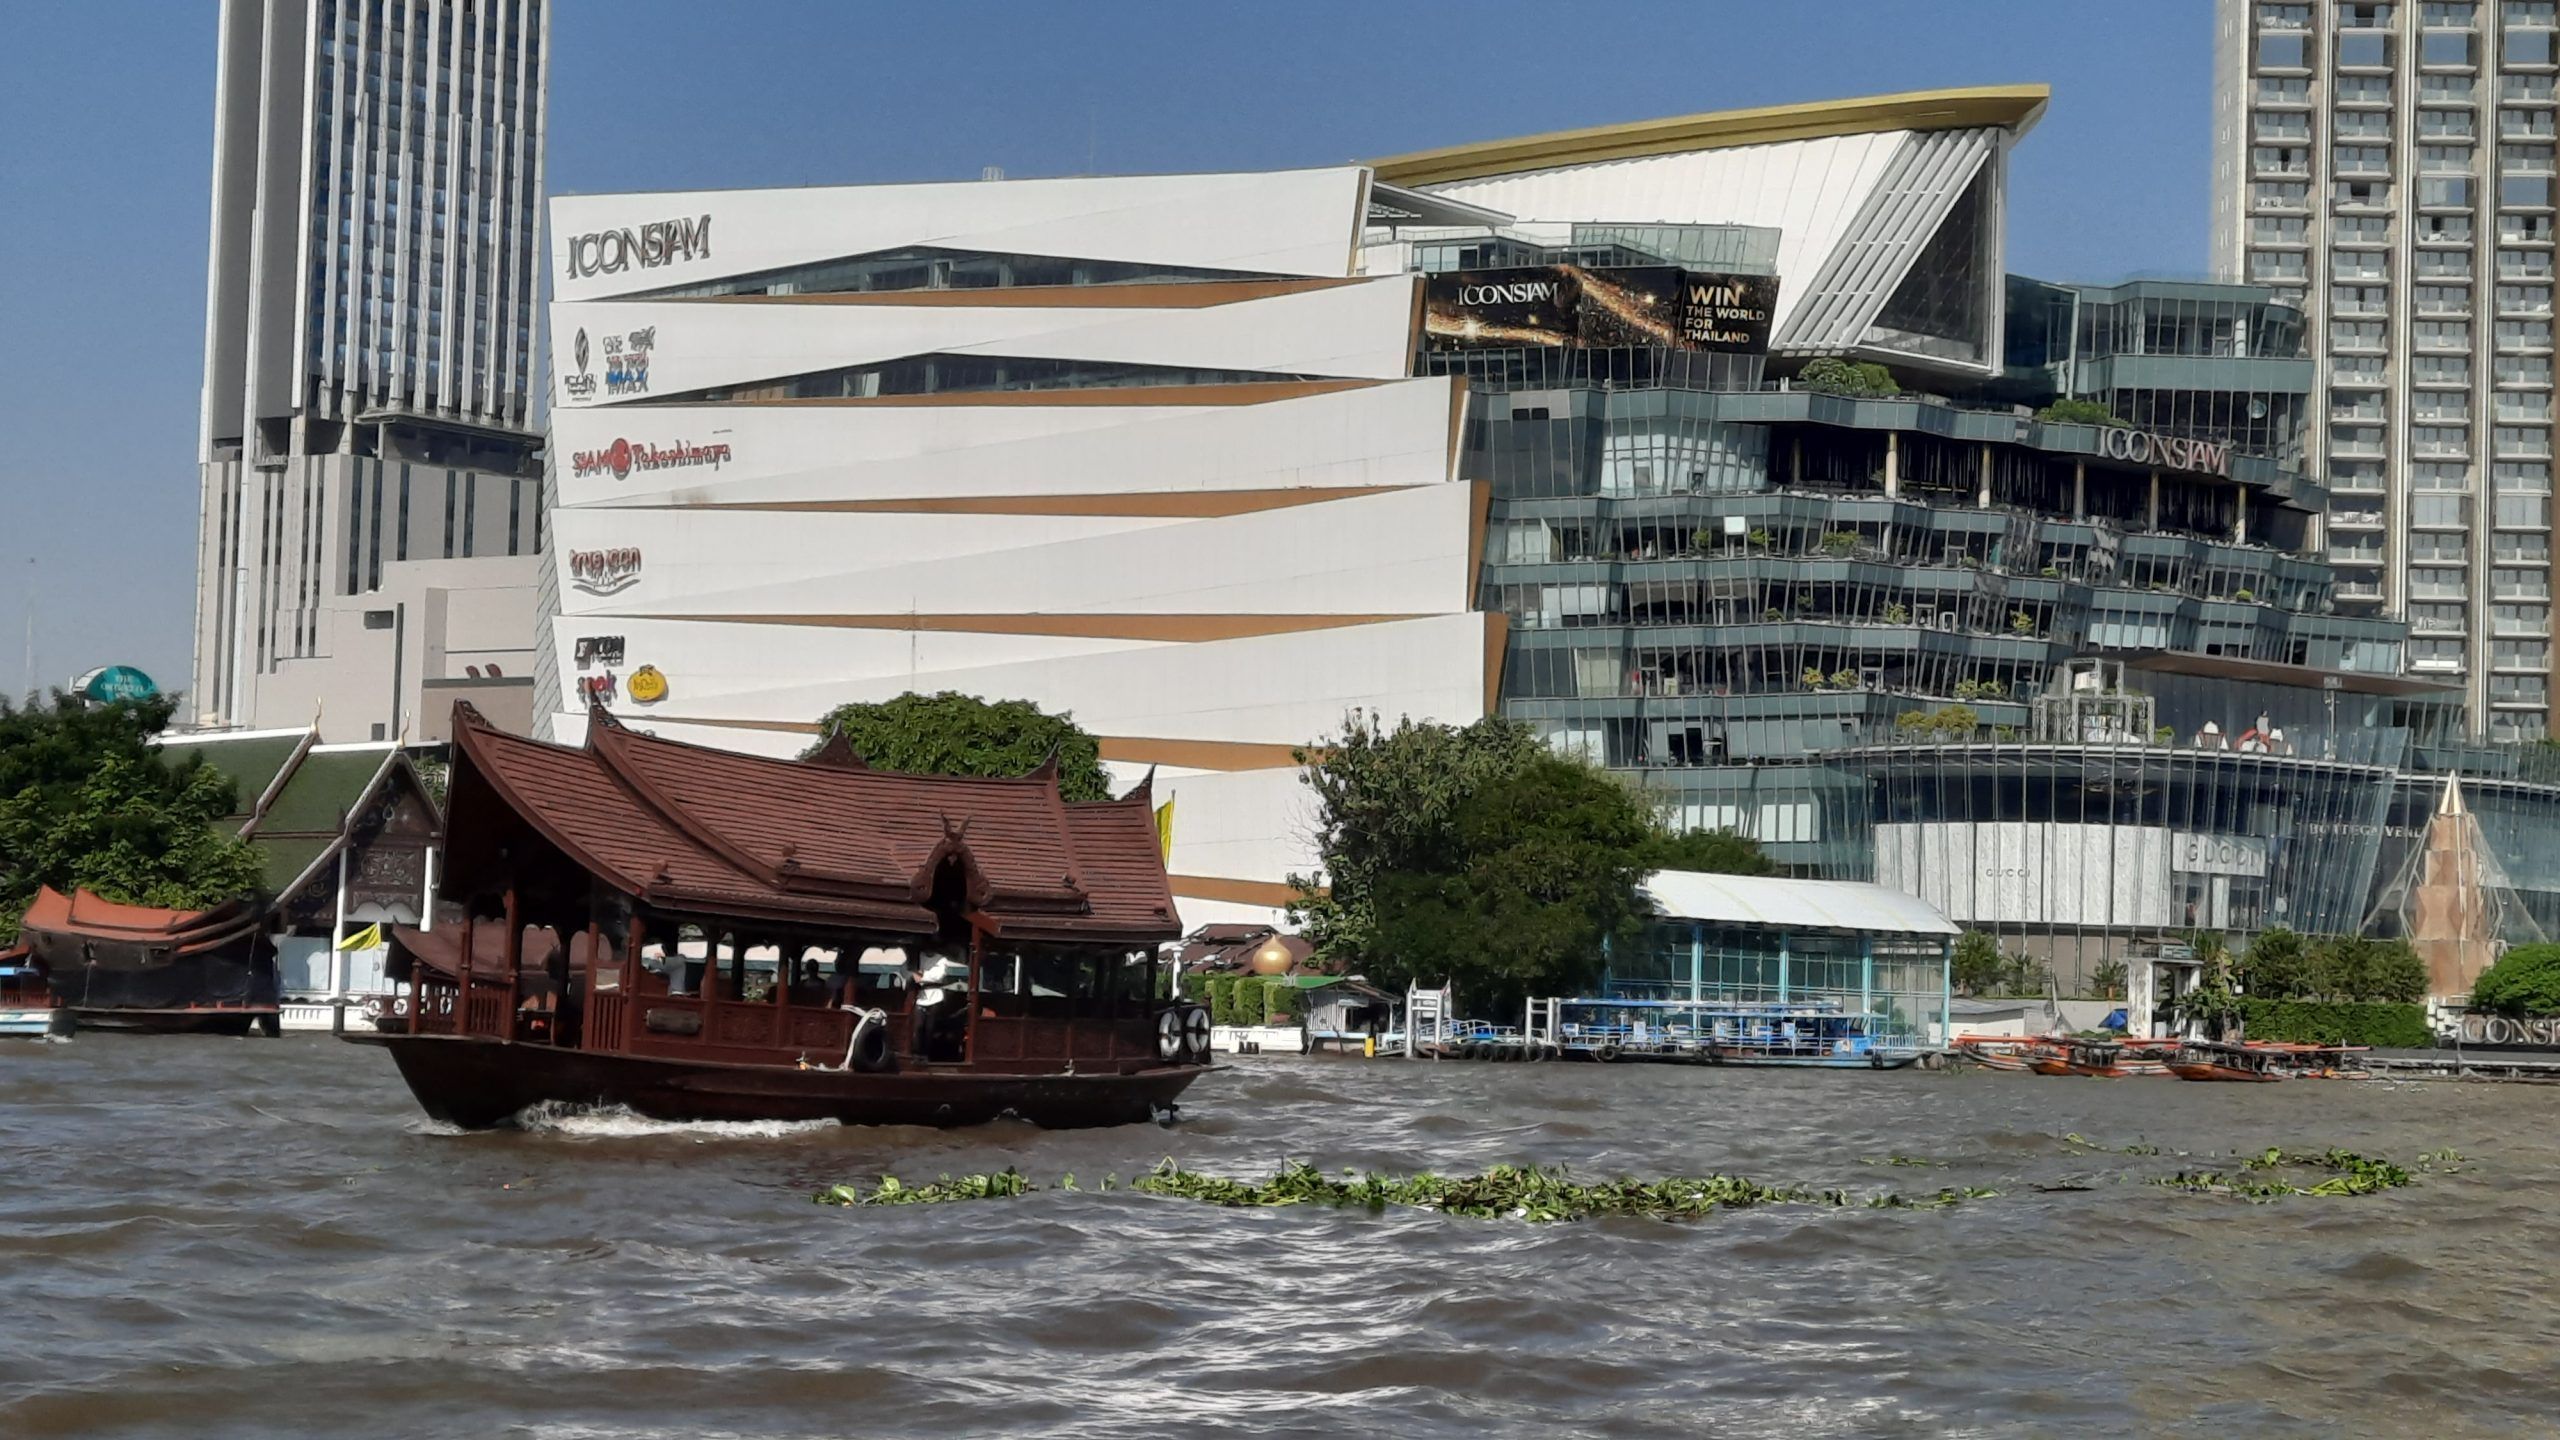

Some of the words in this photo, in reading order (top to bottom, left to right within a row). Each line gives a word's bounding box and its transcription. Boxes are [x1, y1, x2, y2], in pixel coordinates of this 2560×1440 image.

[566, 213, 712, 280] ICONSIAM
[1457, 281, 1559, 306] ICONSIAM
[1689, 284, 1743, 307] WIN
[1685, 317, 1714, 330] FOR
[1686, 305, 1713, 318] THE
[1716, 307, 1766, 322] WORLD
[1684, 329, 1751, 344] THAILAND
[2097, 425, 2228, 476] ICONSIAM
[572, 448, 613, 478] SIAM
[2188, 843, 2257, 867] GUCCI
[1985, 868, 2031, 878] GUCCI
